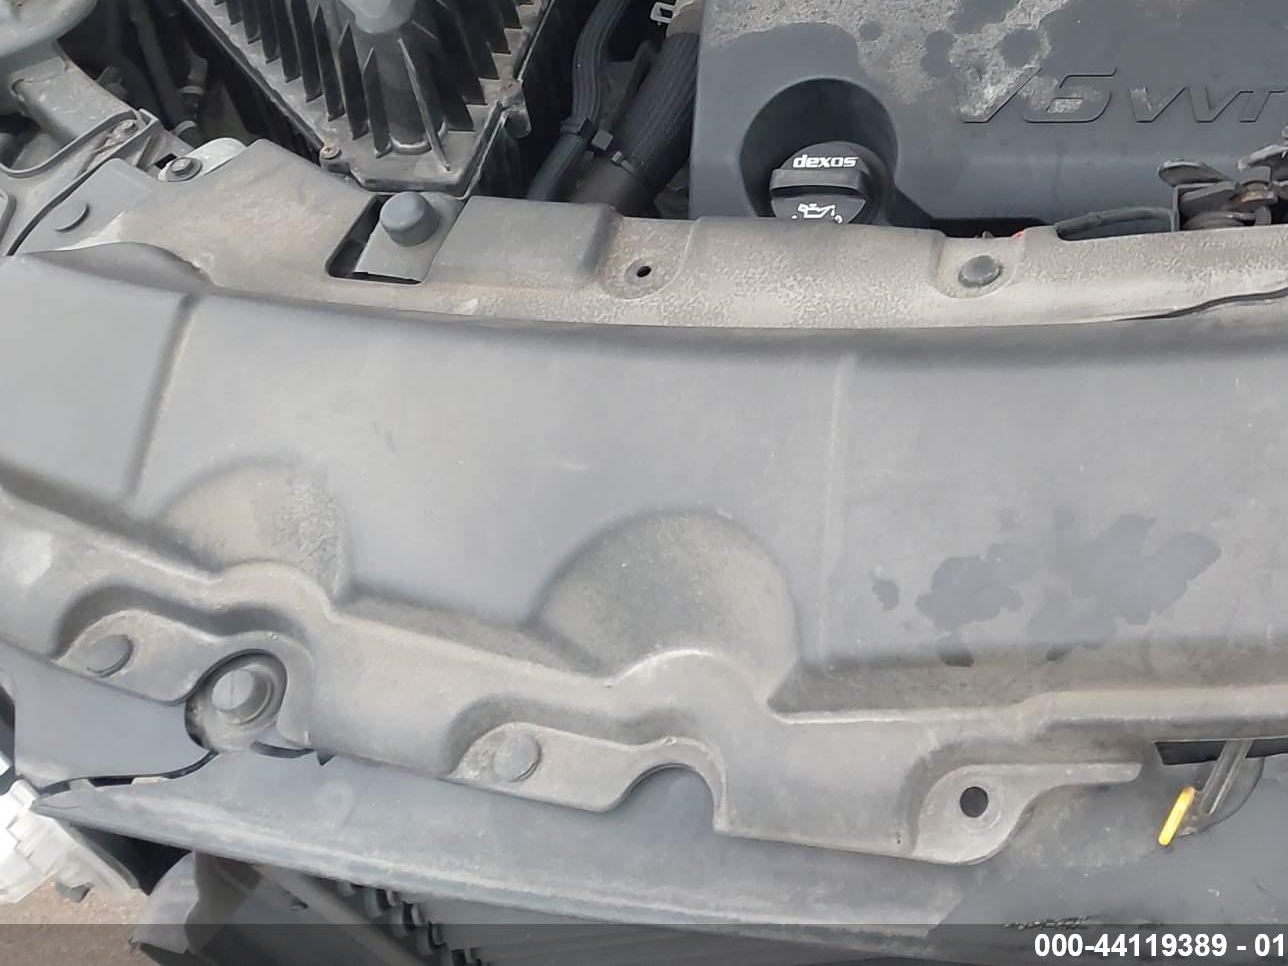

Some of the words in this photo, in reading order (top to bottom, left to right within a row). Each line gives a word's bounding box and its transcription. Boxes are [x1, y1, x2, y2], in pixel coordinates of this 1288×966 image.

[955, 66, 1118, 124] V6
[1128, 85, 1288, 124] VVT
[793, 154, 859, 168] dexos
